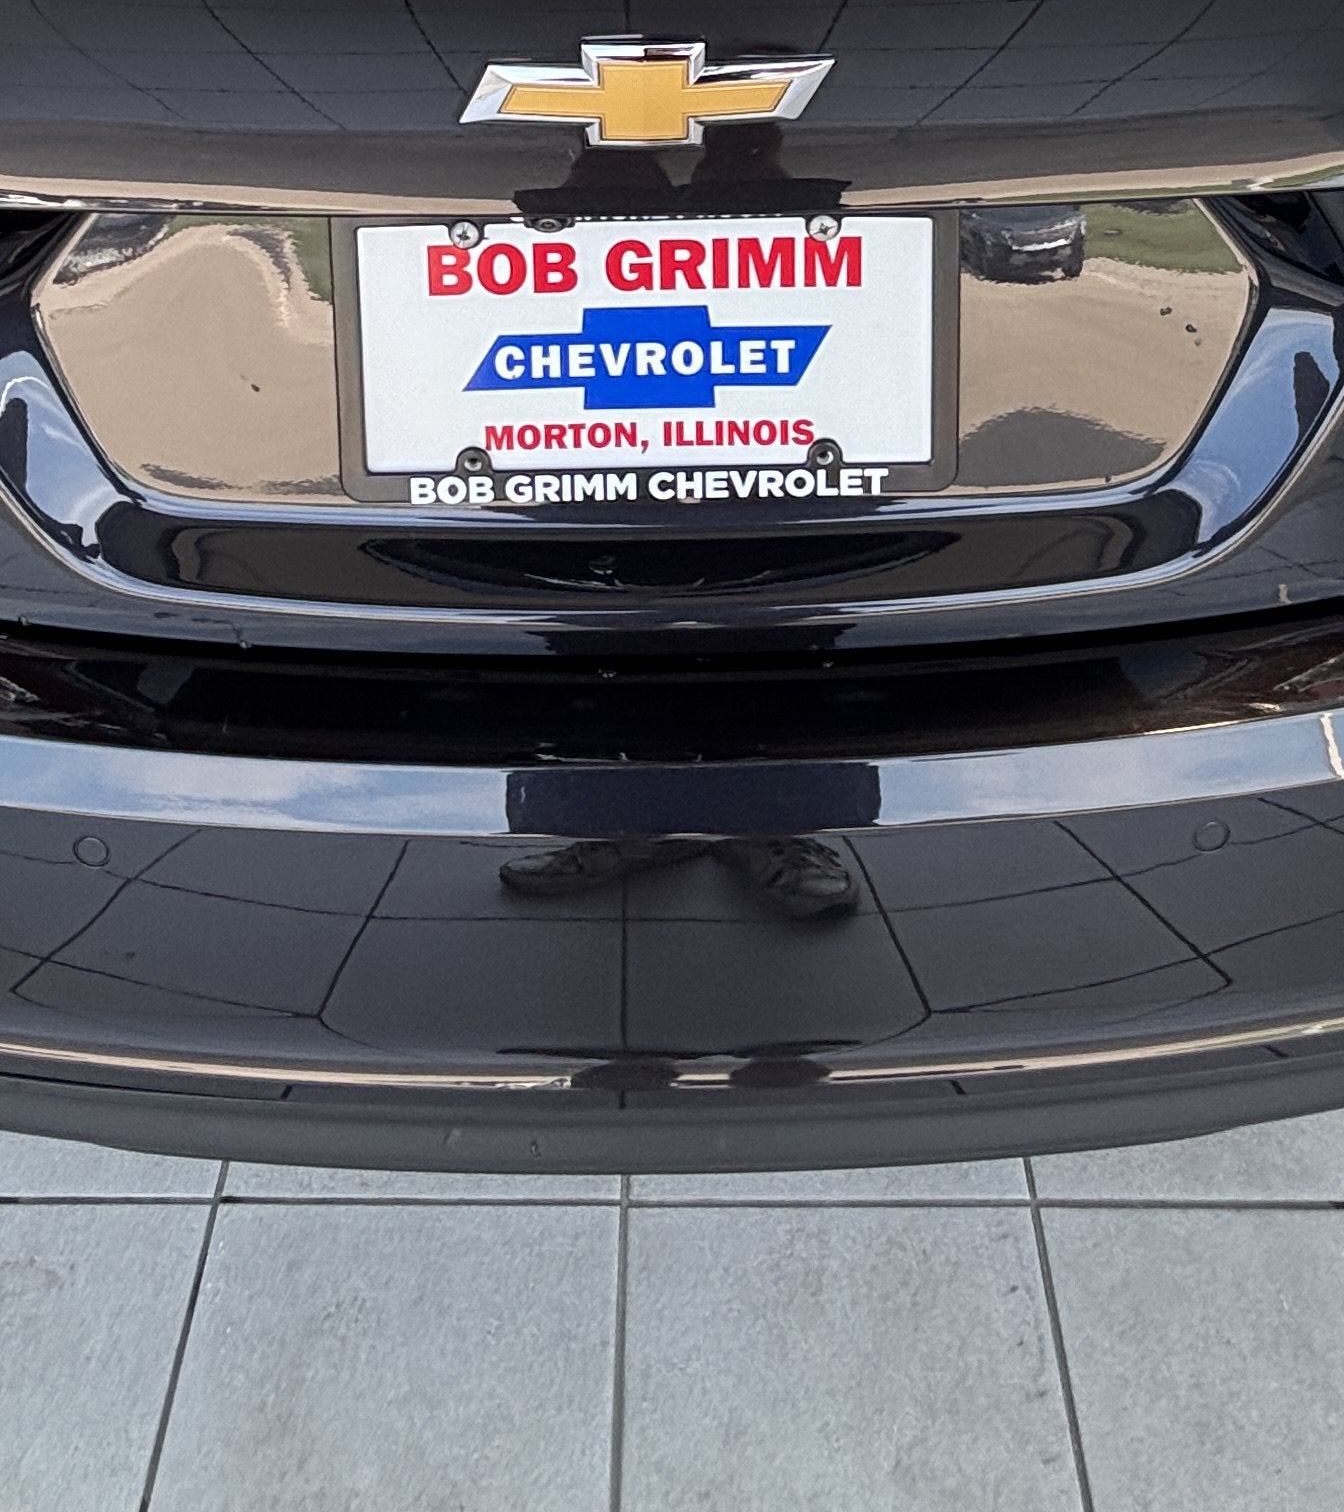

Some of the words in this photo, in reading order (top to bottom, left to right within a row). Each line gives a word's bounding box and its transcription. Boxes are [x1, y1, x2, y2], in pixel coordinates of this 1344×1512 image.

[426, 242, 579, 298] BOB
[605, 235, 864, 292] GRIMM
[493, 338, 797, 381] CHEVROLET
[485, 421, 650, 454] MORTON,
[662, 418, 815, 449] ILLINOIS
[409, 475, 495, 506] BOB
[503, 471, 639, 504] GRIMM
[647, 467, 889, 501] CHEVROLET
